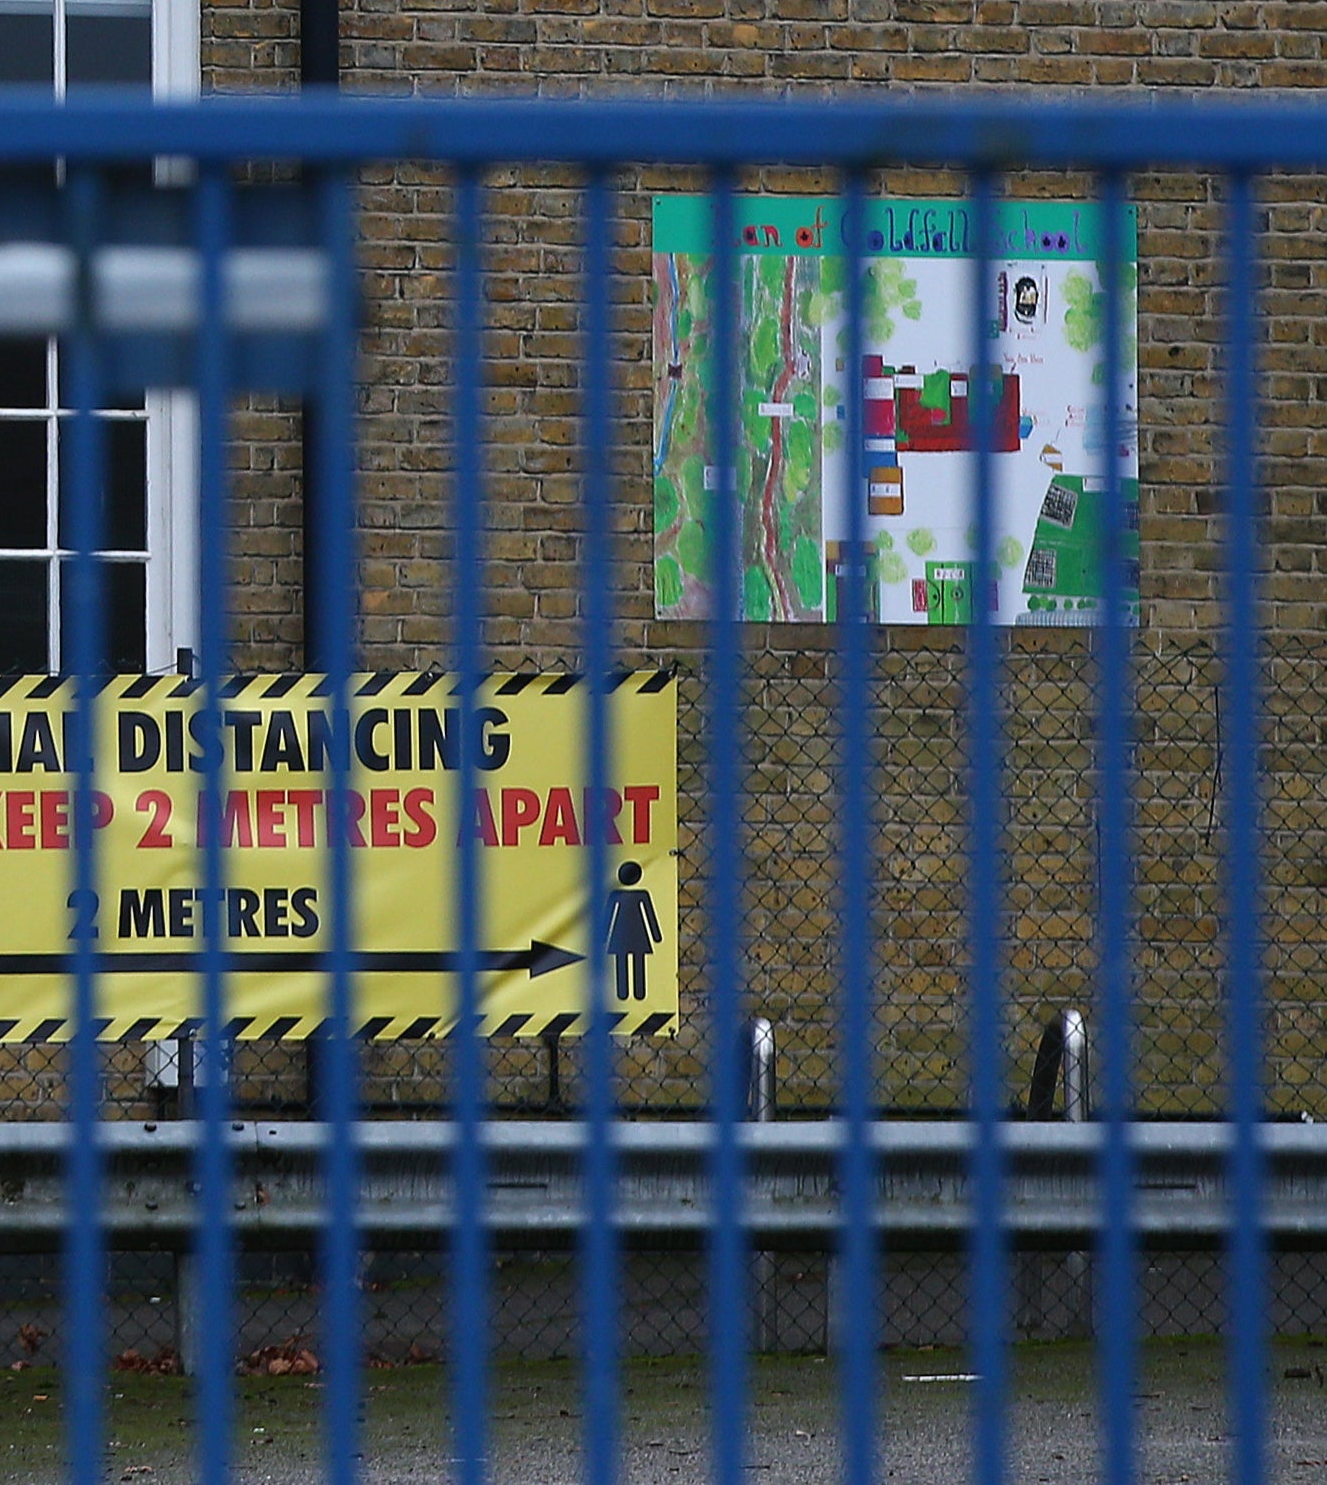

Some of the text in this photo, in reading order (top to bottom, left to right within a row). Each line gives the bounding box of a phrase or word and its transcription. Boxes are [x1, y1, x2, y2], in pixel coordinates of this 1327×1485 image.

[794, 204, 828, 249] of
[118, 707, 511, 773] DISTANCING
[135, 790, 173, 849] 2
[196, 787, 437, 848] METRES
[456, 785, 660, 846] APART
[66, 887, 320, 939] 2 METRES
